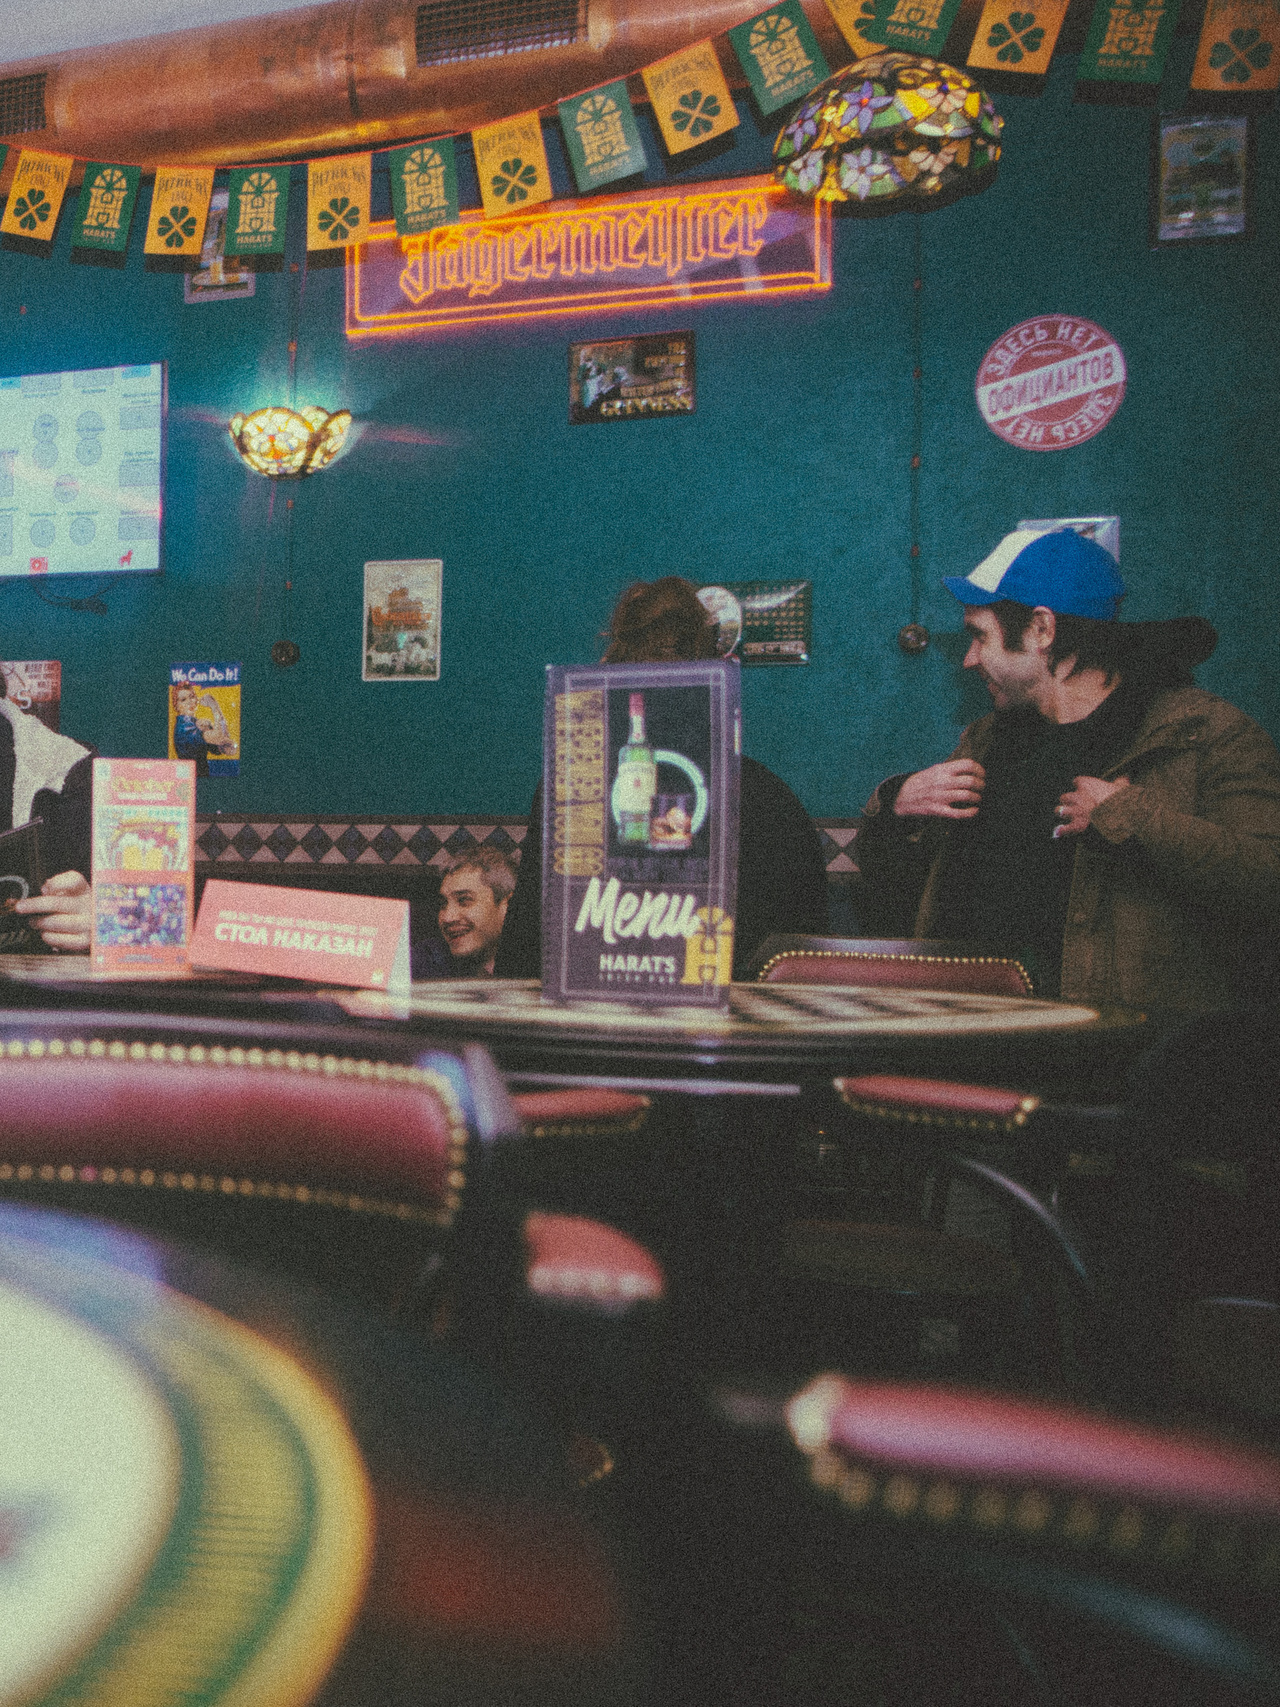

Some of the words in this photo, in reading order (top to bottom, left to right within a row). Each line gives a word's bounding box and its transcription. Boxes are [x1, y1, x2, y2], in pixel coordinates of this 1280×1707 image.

[987, 325, 1049, 376] ЗДЕСЬ
[1056, 321, 1099, 348] НЕТ
[988, 352, 1114, 415] ОФИЦИАНТОВ
[600, 395, 693, 416] GUINNESS
[1051, 392, 1113, 441] ЗДЕСЬ
[1004, 417, 1045, 442] НЕТ
[171, 668, 187, 682] We
[188, 667, 208, 682] Can
[209, 667, 224, 682] Do
[225, 667, 238, 681] It!
[574, 875, 701, 944] Menu
[215, 922, 268, 945] СТОЛ
[272, 928, 374, 958] НАКАЗАН
